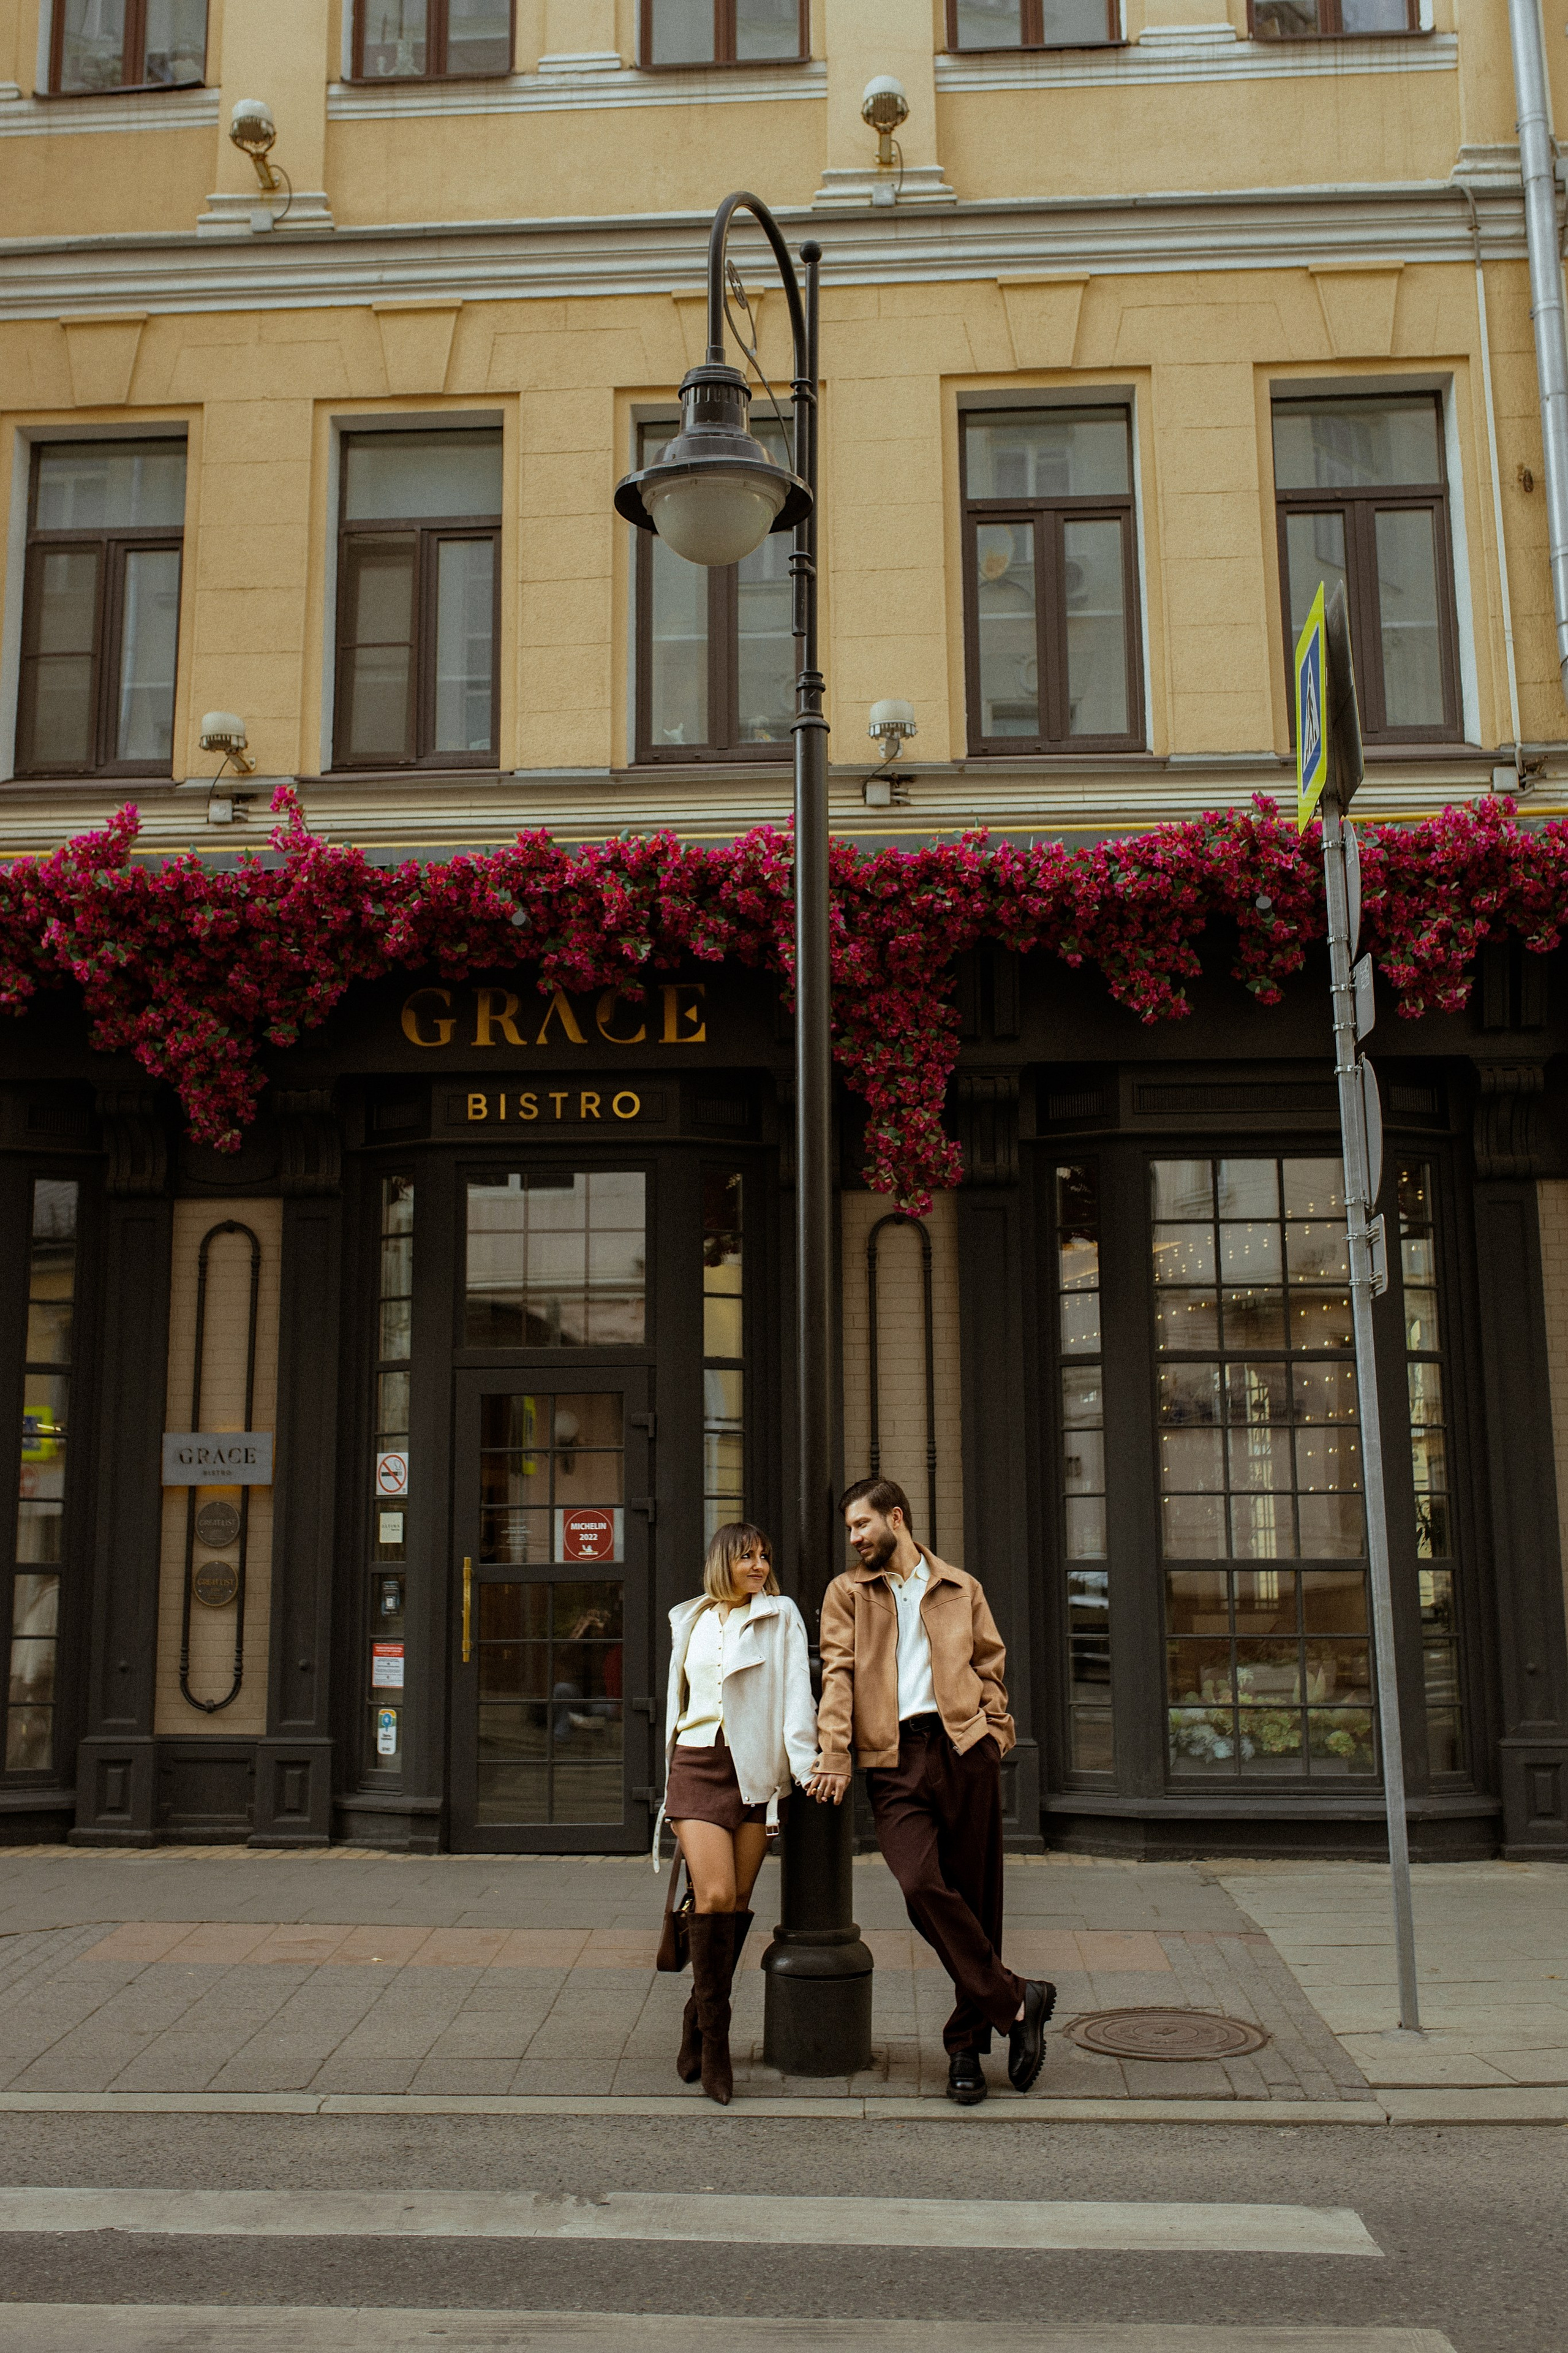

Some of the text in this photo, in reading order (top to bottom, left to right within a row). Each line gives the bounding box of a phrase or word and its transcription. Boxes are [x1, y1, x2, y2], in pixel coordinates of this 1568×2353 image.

[401, 983, 707, 1048] GRACE
[467, 1090, 641, 1121] BISTRO
[178, 1447, 257, 1465] GRACE
